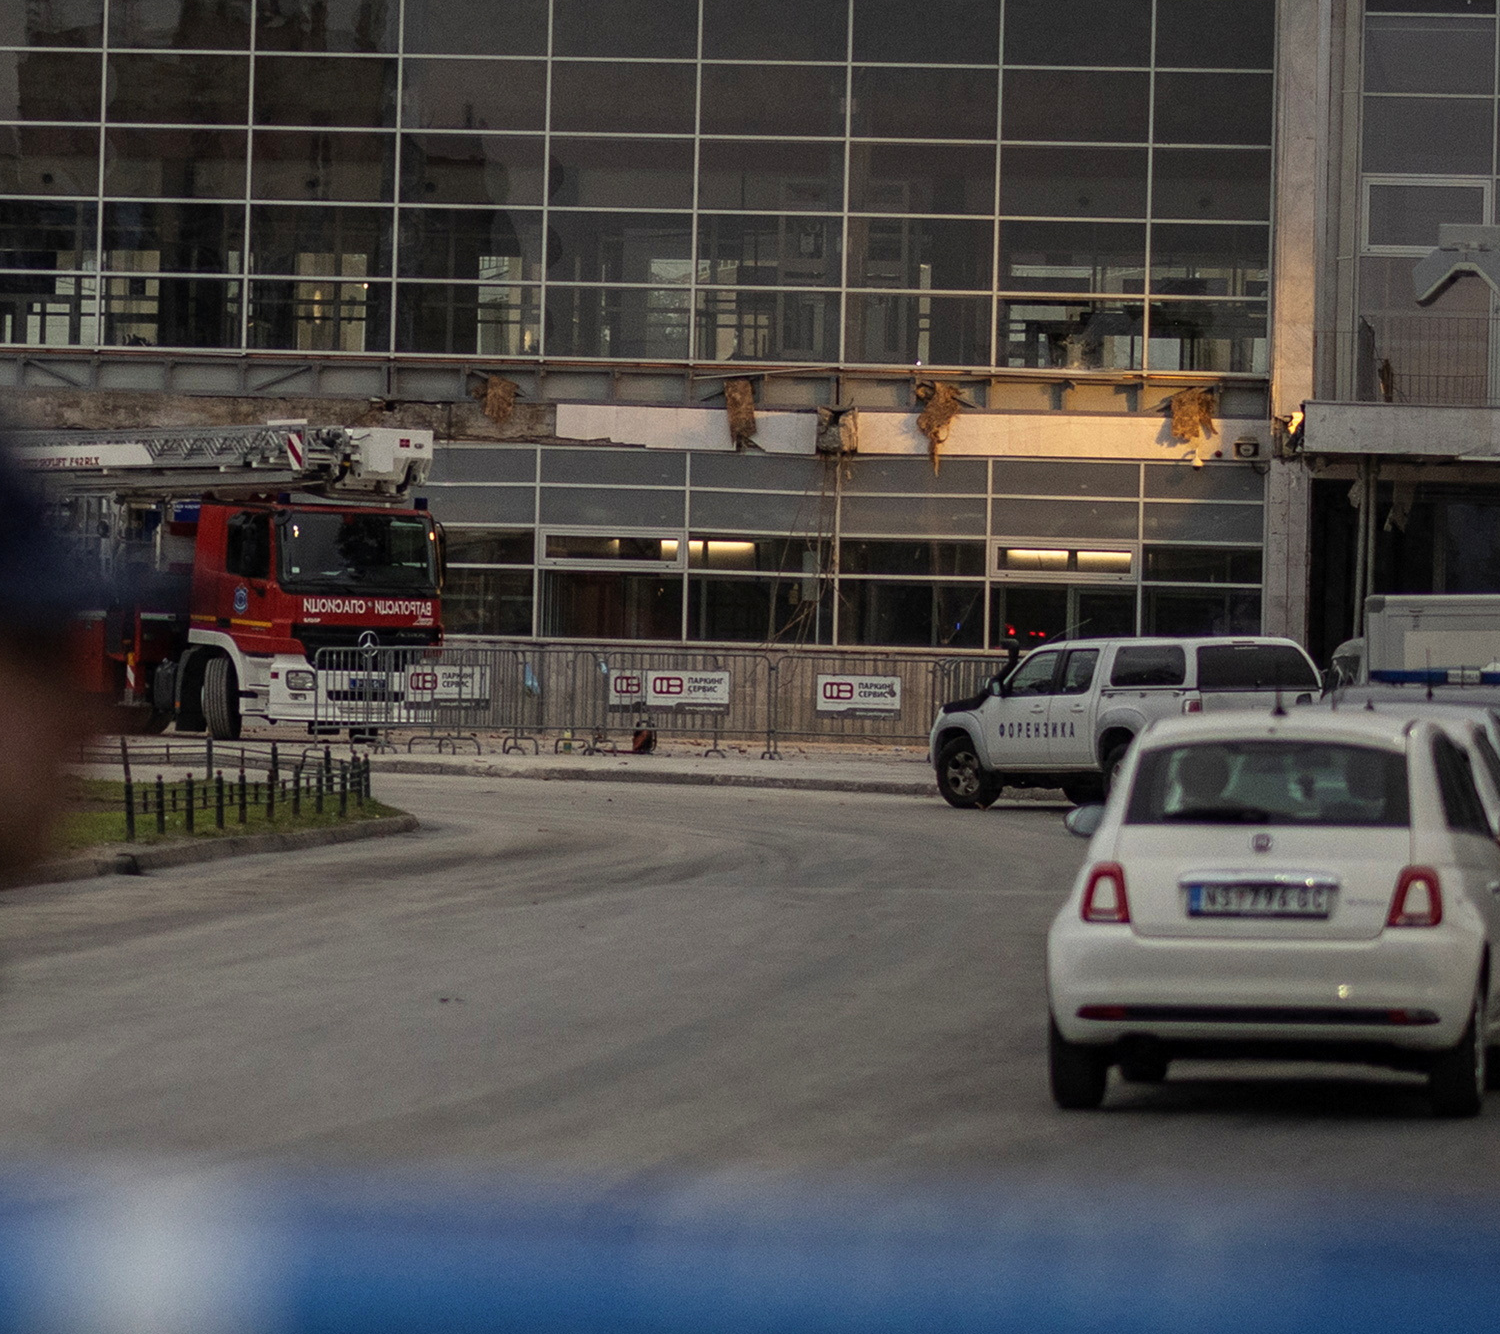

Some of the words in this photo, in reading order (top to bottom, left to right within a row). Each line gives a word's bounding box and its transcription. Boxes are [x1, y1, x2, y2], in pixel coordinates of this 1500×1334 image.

[687, 677, 724, 685] ПАРКИНГ
[687, 685, 718, 693] СЕРВИС
[858, 682, 891, 690] ПАРКИН
[858, 690, 889, 699] СЕРВИС
[999, 722, 1075, 738] ФОРЕНЗИКА
